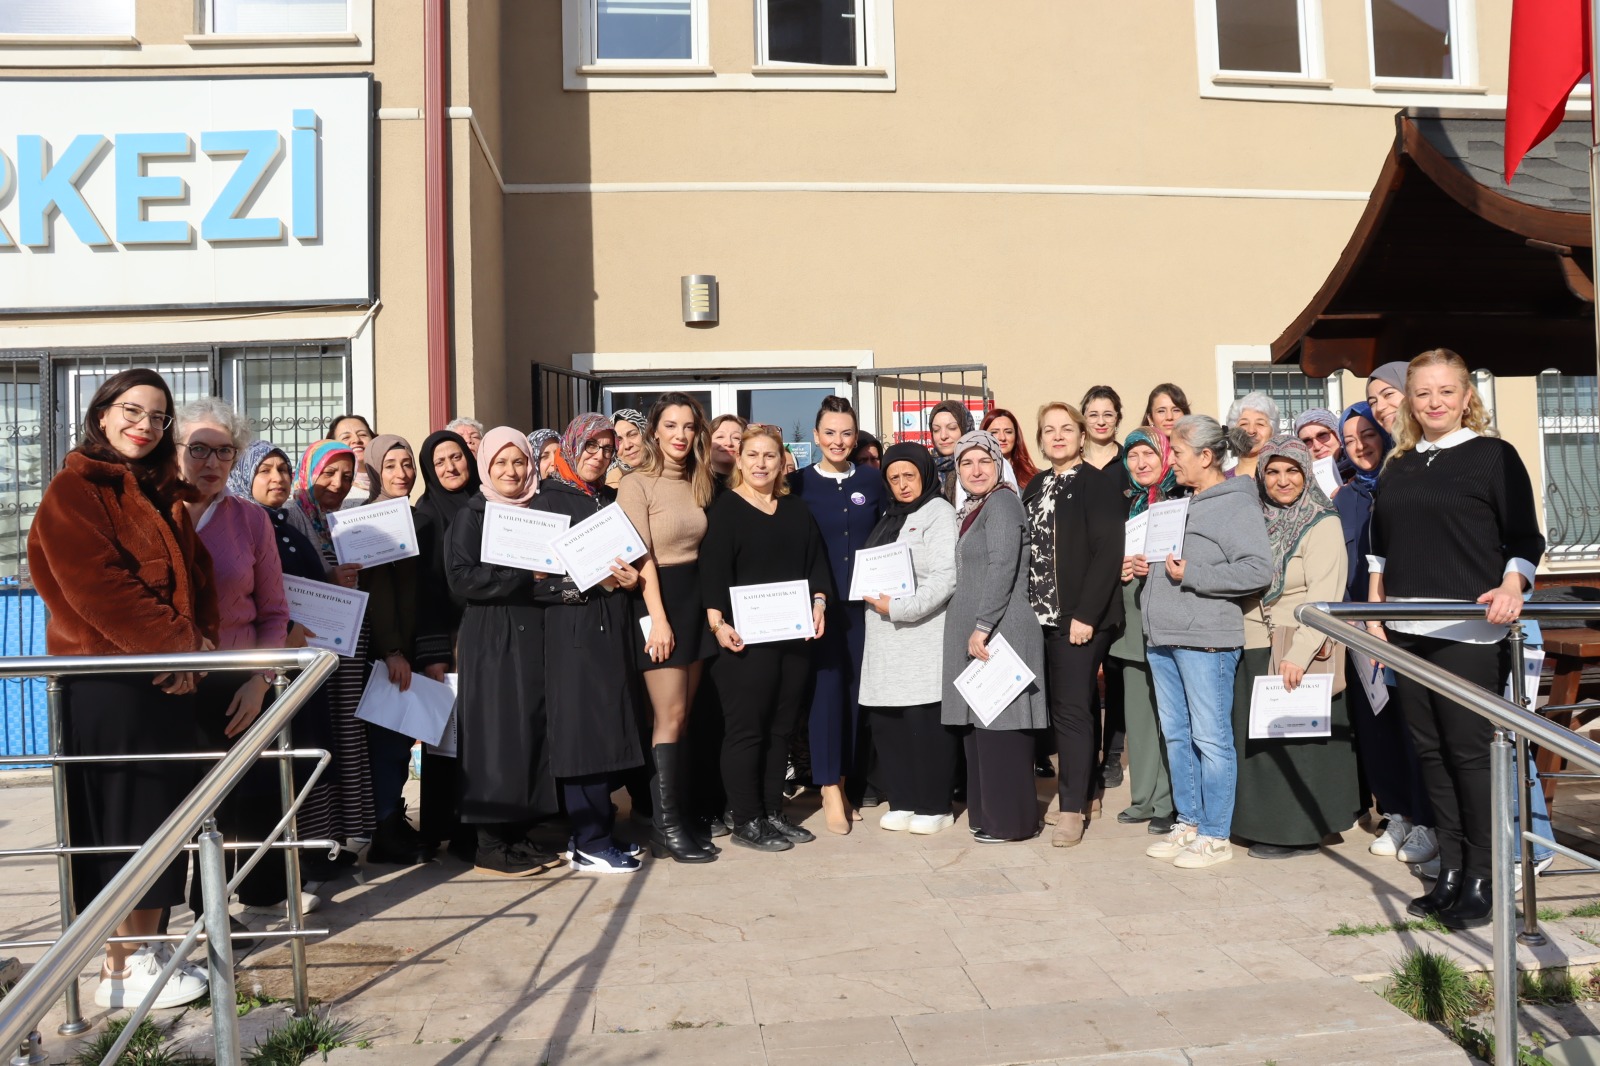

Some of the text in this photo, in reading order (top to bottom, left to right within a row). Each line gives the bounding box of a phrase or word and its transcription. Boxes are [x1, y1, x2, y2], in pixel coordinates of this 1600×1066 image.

[0, 109, 318, 247] KEZİ
[288, 586, 352, 605] KATILIM SERTİFİKASI
